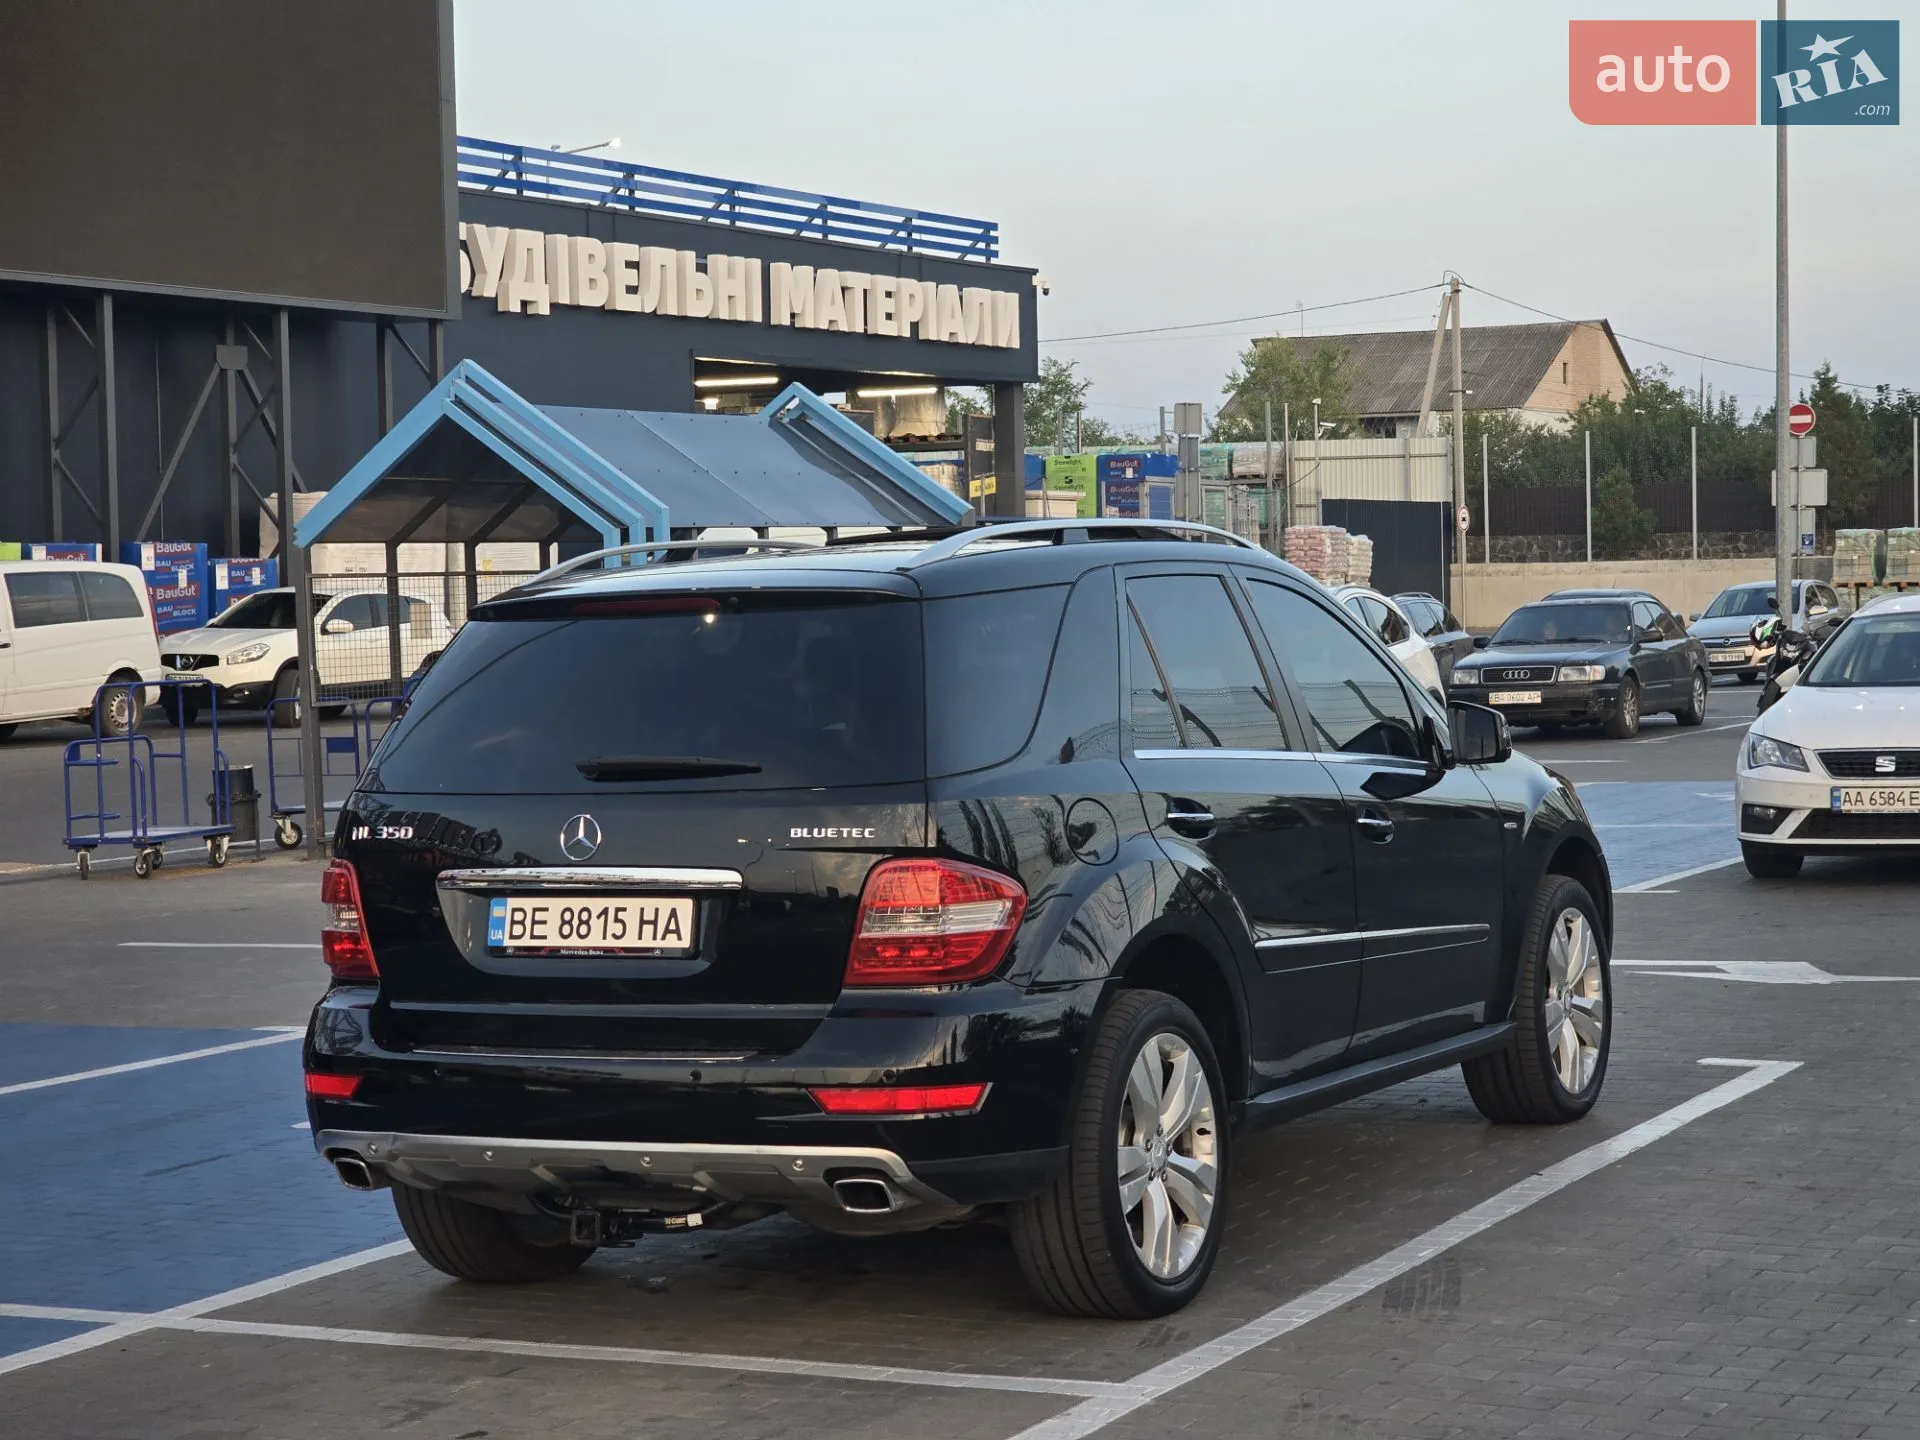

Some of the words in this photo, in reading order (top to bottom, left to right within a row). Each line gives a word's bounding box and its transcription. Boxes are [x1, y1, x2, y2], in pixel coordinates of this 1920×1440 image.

[770, 262, 1020, 349] МАТЕРІАЛИ
[156, 585, 197, 600] BauGut
[173, 609, 197, 617] BLOCK
[1842, 791, 1865, 807] AA
[1868, 791, 1907, 807] 6584
[375, 826, 414, 839] 350
[790, 827, 876, 838] BLUETEC
[508, 907, 550, 940] BE
[558, 906, 628, 941] 8815
[637, 907, 683, 942] HA
[489, 930, 504, 941] UA
